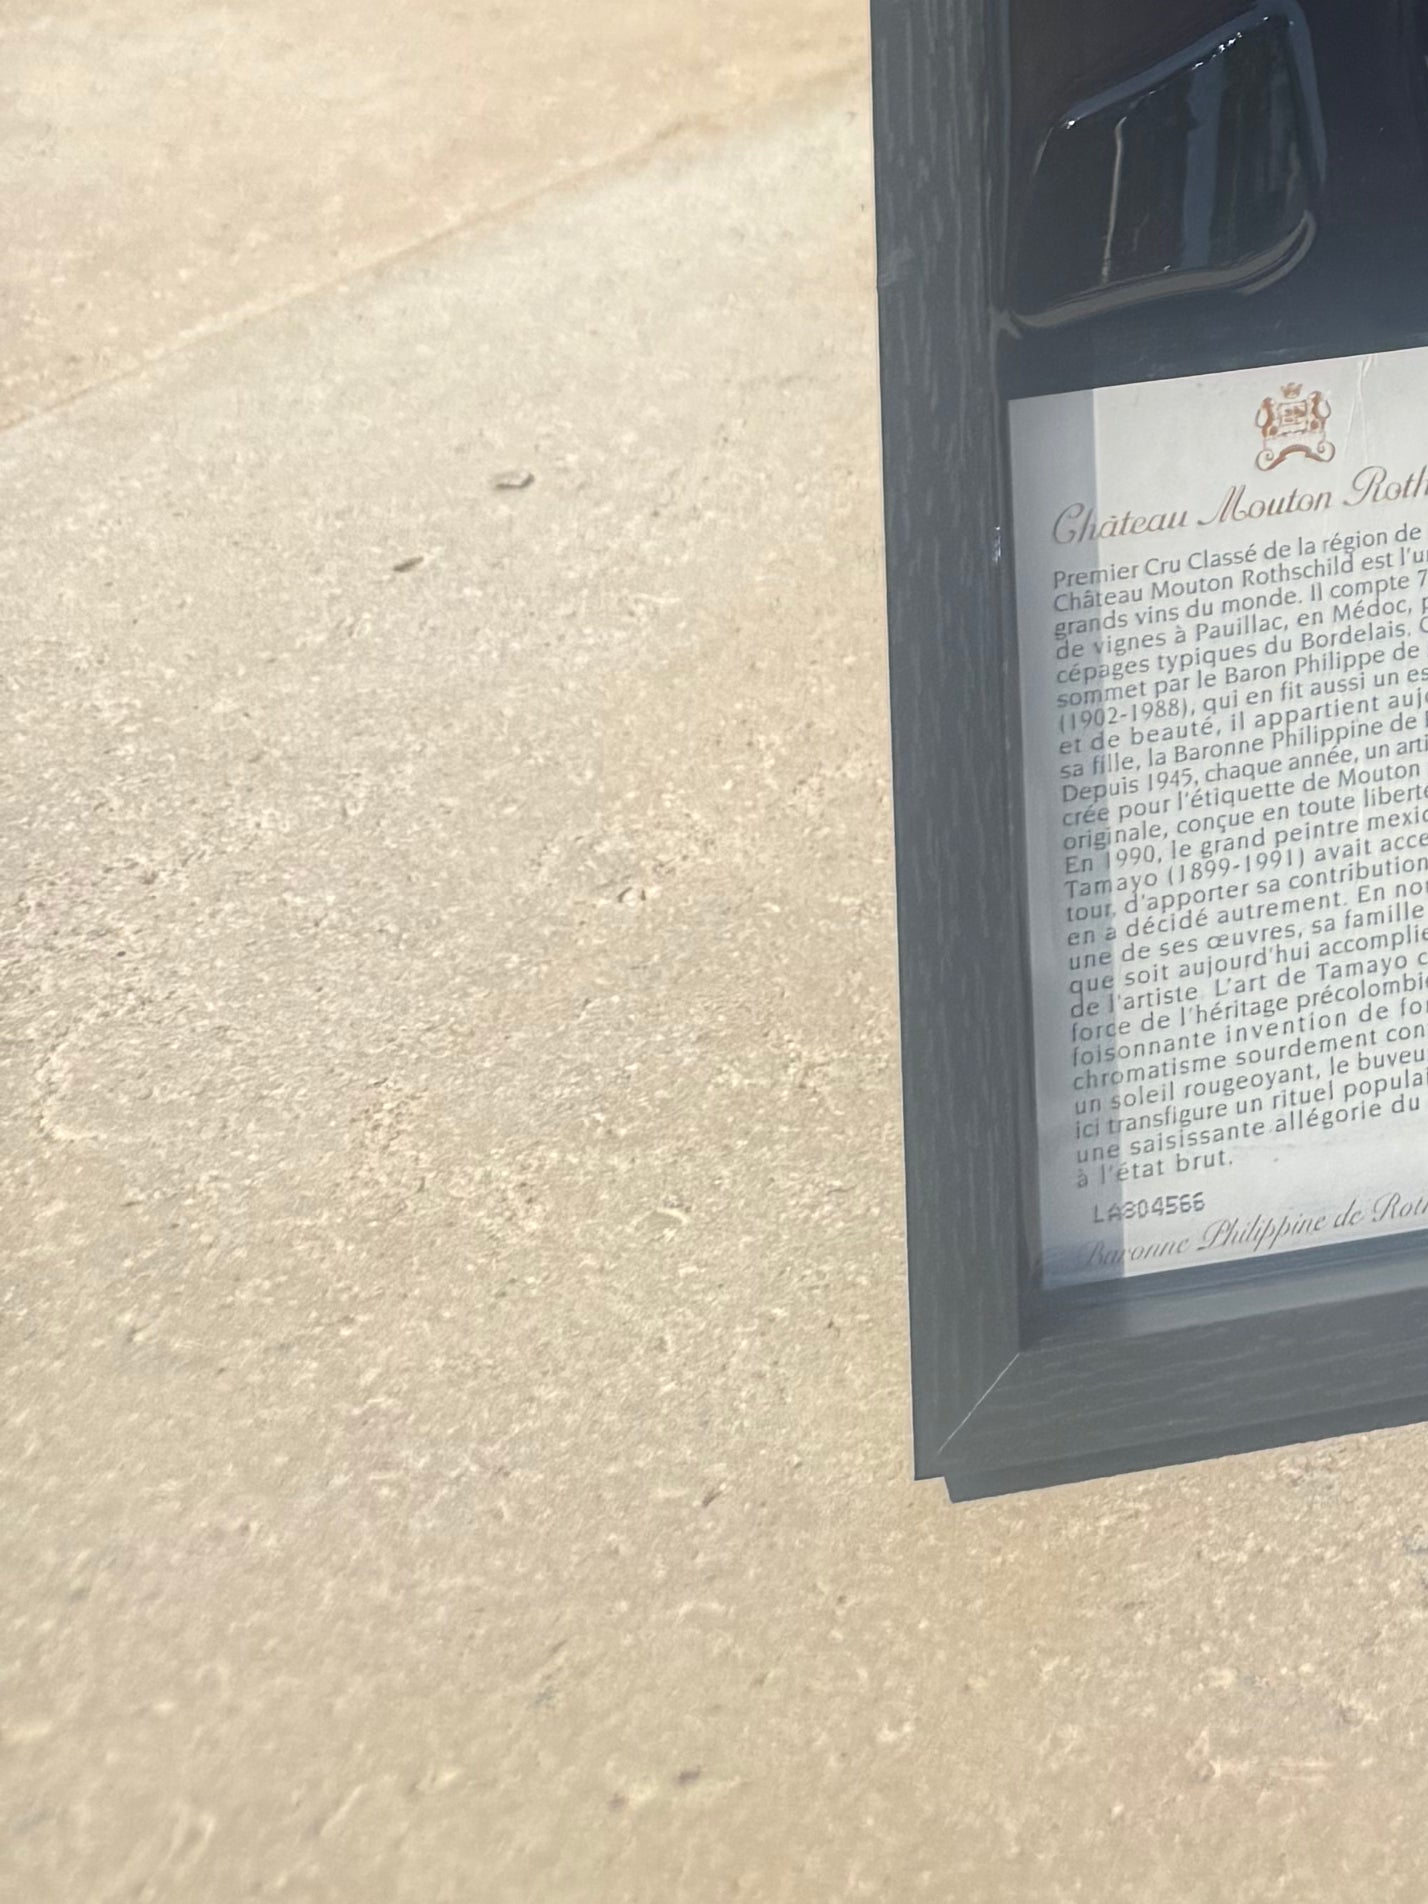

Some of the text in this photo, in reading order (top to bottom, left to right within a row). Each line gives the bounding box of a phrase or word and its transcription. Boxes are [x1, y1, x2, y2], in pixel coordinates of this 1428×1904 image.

[1051, 501, 1188, 545] Château
[1196, 484, 1332, 526] Mouton
[1052, 587, 1143, 613] Château
[1150, 575, 1233, 600] Mouton
[1241, 555, 1354, 588] Rothschild
[1360, 551, 1393, 572] est
[1053, 564, 1137, 589] Premier
[1143, 558, 1181, 577] Cru
[1186, 546, 1257, 570] Classé
[1262, 542, 1291, 561] de
[1297, 539, 1316, 556] la
[1322, 531, 1388, 557] région
[1394, 525, 1422, 543] de
[1054, 611, 1128, 641] grands
[1134, 606, 1179, 625] vins
[1185, 600, 1213, 619] du
[1220, 589, 1303, 614] monde.
[1310, 583, 1323, 602] Il
[1329, 575, 1410, 601] compte
[1056, 658, 1150, 685] cépages
[1156, 643, 1257, 675] typiques
[1263, 637, 1292, 655] du
[1300, 621, 1411, 651] Bordelais.
[1056, 680, 1146, 708] sommet
[1153, 678, 1189, 699] par
[1197, 671, 1216, 689] le
[1224, 663, 1286, 685] Baron
[1294, 649, 1385, 676] Philippe
[1391, 642, 1420, 661] de
[1058, 697, 1195, 734] (1902-1988),
[1202, 690, 1238, 715] qui
[1245, 690, 1273, 705] en
[1280, 682, 1303, 701] fit
[1309, 672, 1365, 696] aussi
[1373, 672, 1399, 688] un
[1062, 821, 1168, 851] originale,
[1176, 811, 1254, 835] conçue
[1262, 806, 1289, 822] en
[1297, 795, 1355, 817] toute
[1063, 872, 1157, 898] Tamayo
[1167, 847, 1304, 886] (1899-1991)
[1313, 838, 1372, 863] avait
[1068, 976, 1114, 999] que
[1124, 964, 1168, 987] soit
[1178, 941, 1310, 978] aujourd'hui
[1071, 1020, 1131, 1042] force
[1140, 1013, 1171, 1032] de
[1180, 996, 1288, 1026] l'héritage
[1072, 1031, 1216, 1067] foisonnante
[1225, 1011, 1347, 1044] invention
[1358, 1004, 1389, 1023] de
[1072, 1054, 1227, 1091] chromatisme
[1235, 1029, 1377, 1066] sourdement
[1074, 1099, 1101, 1115] un
[1110, 1083, 1174, 1110] soleil
[1184, 1063, 1321, 1099] rougeoyant,
[1329, 1058, 1349, 1076] le
[1075, 1119, 1100, 1140] ici
[1107, 1102, 1228, 1135] transfigure
[1235, 1099, 1263, 1115] un
[1272, 1082, 1334, 1110] rituel
[1076, 1145, 1120, 1164] une
[1129, 1121, 1265, 1156] saisissante
[1274, 1102, 1382, 1133] allégorie
[1390, 1095, 1420, 1114] du
[1076, 1149, 1232, 1189] à l'état brut.
[1080, 1237, 1190, 1271] Baronne
